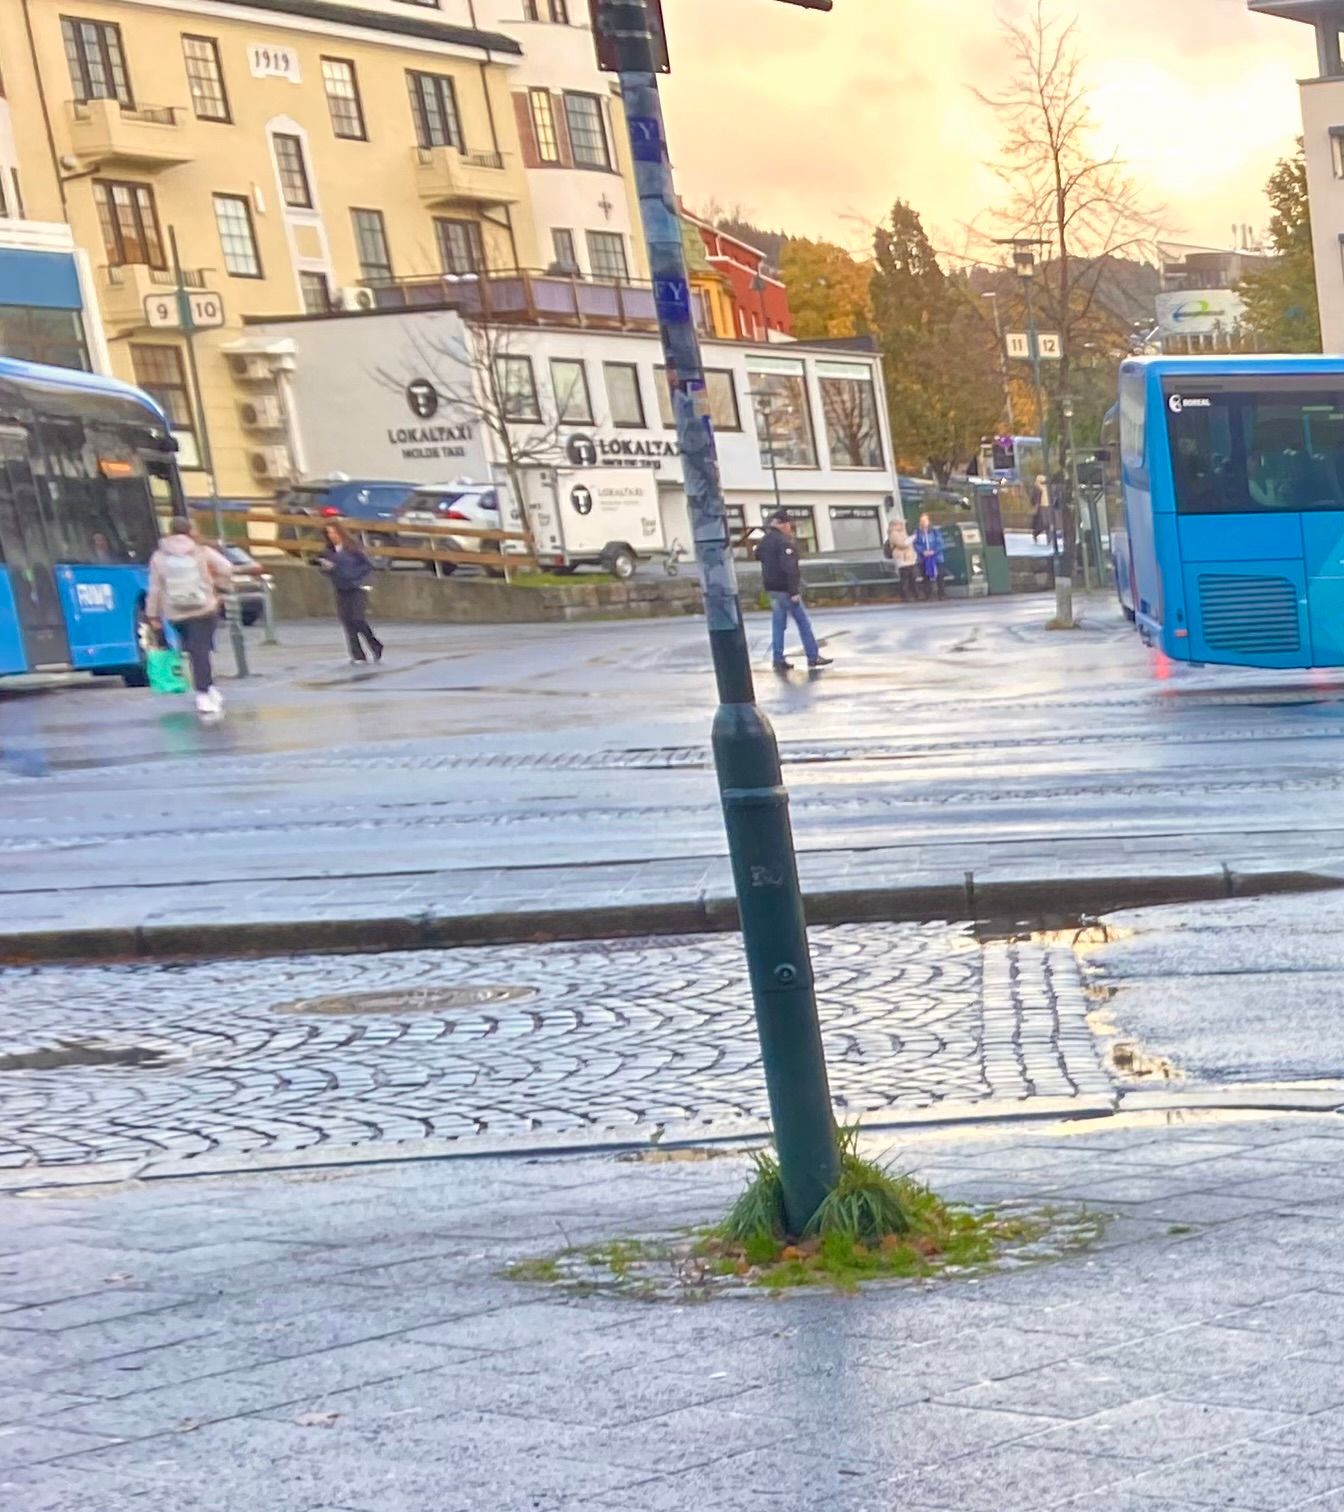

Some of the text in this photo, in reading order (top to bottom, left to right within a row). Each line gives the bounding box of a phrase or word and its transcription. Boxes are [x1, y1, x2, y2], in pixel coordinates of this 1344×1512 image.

[254, 49, 290, 72] 1919
[157, 303, 168, 320] 9
[196, 301, 217, 318] 10
[1012, 338, 1023, 352] 11
[1042, 339, 1056, 352] 12
[387, 425, 473, 444] LOKALTAXI
